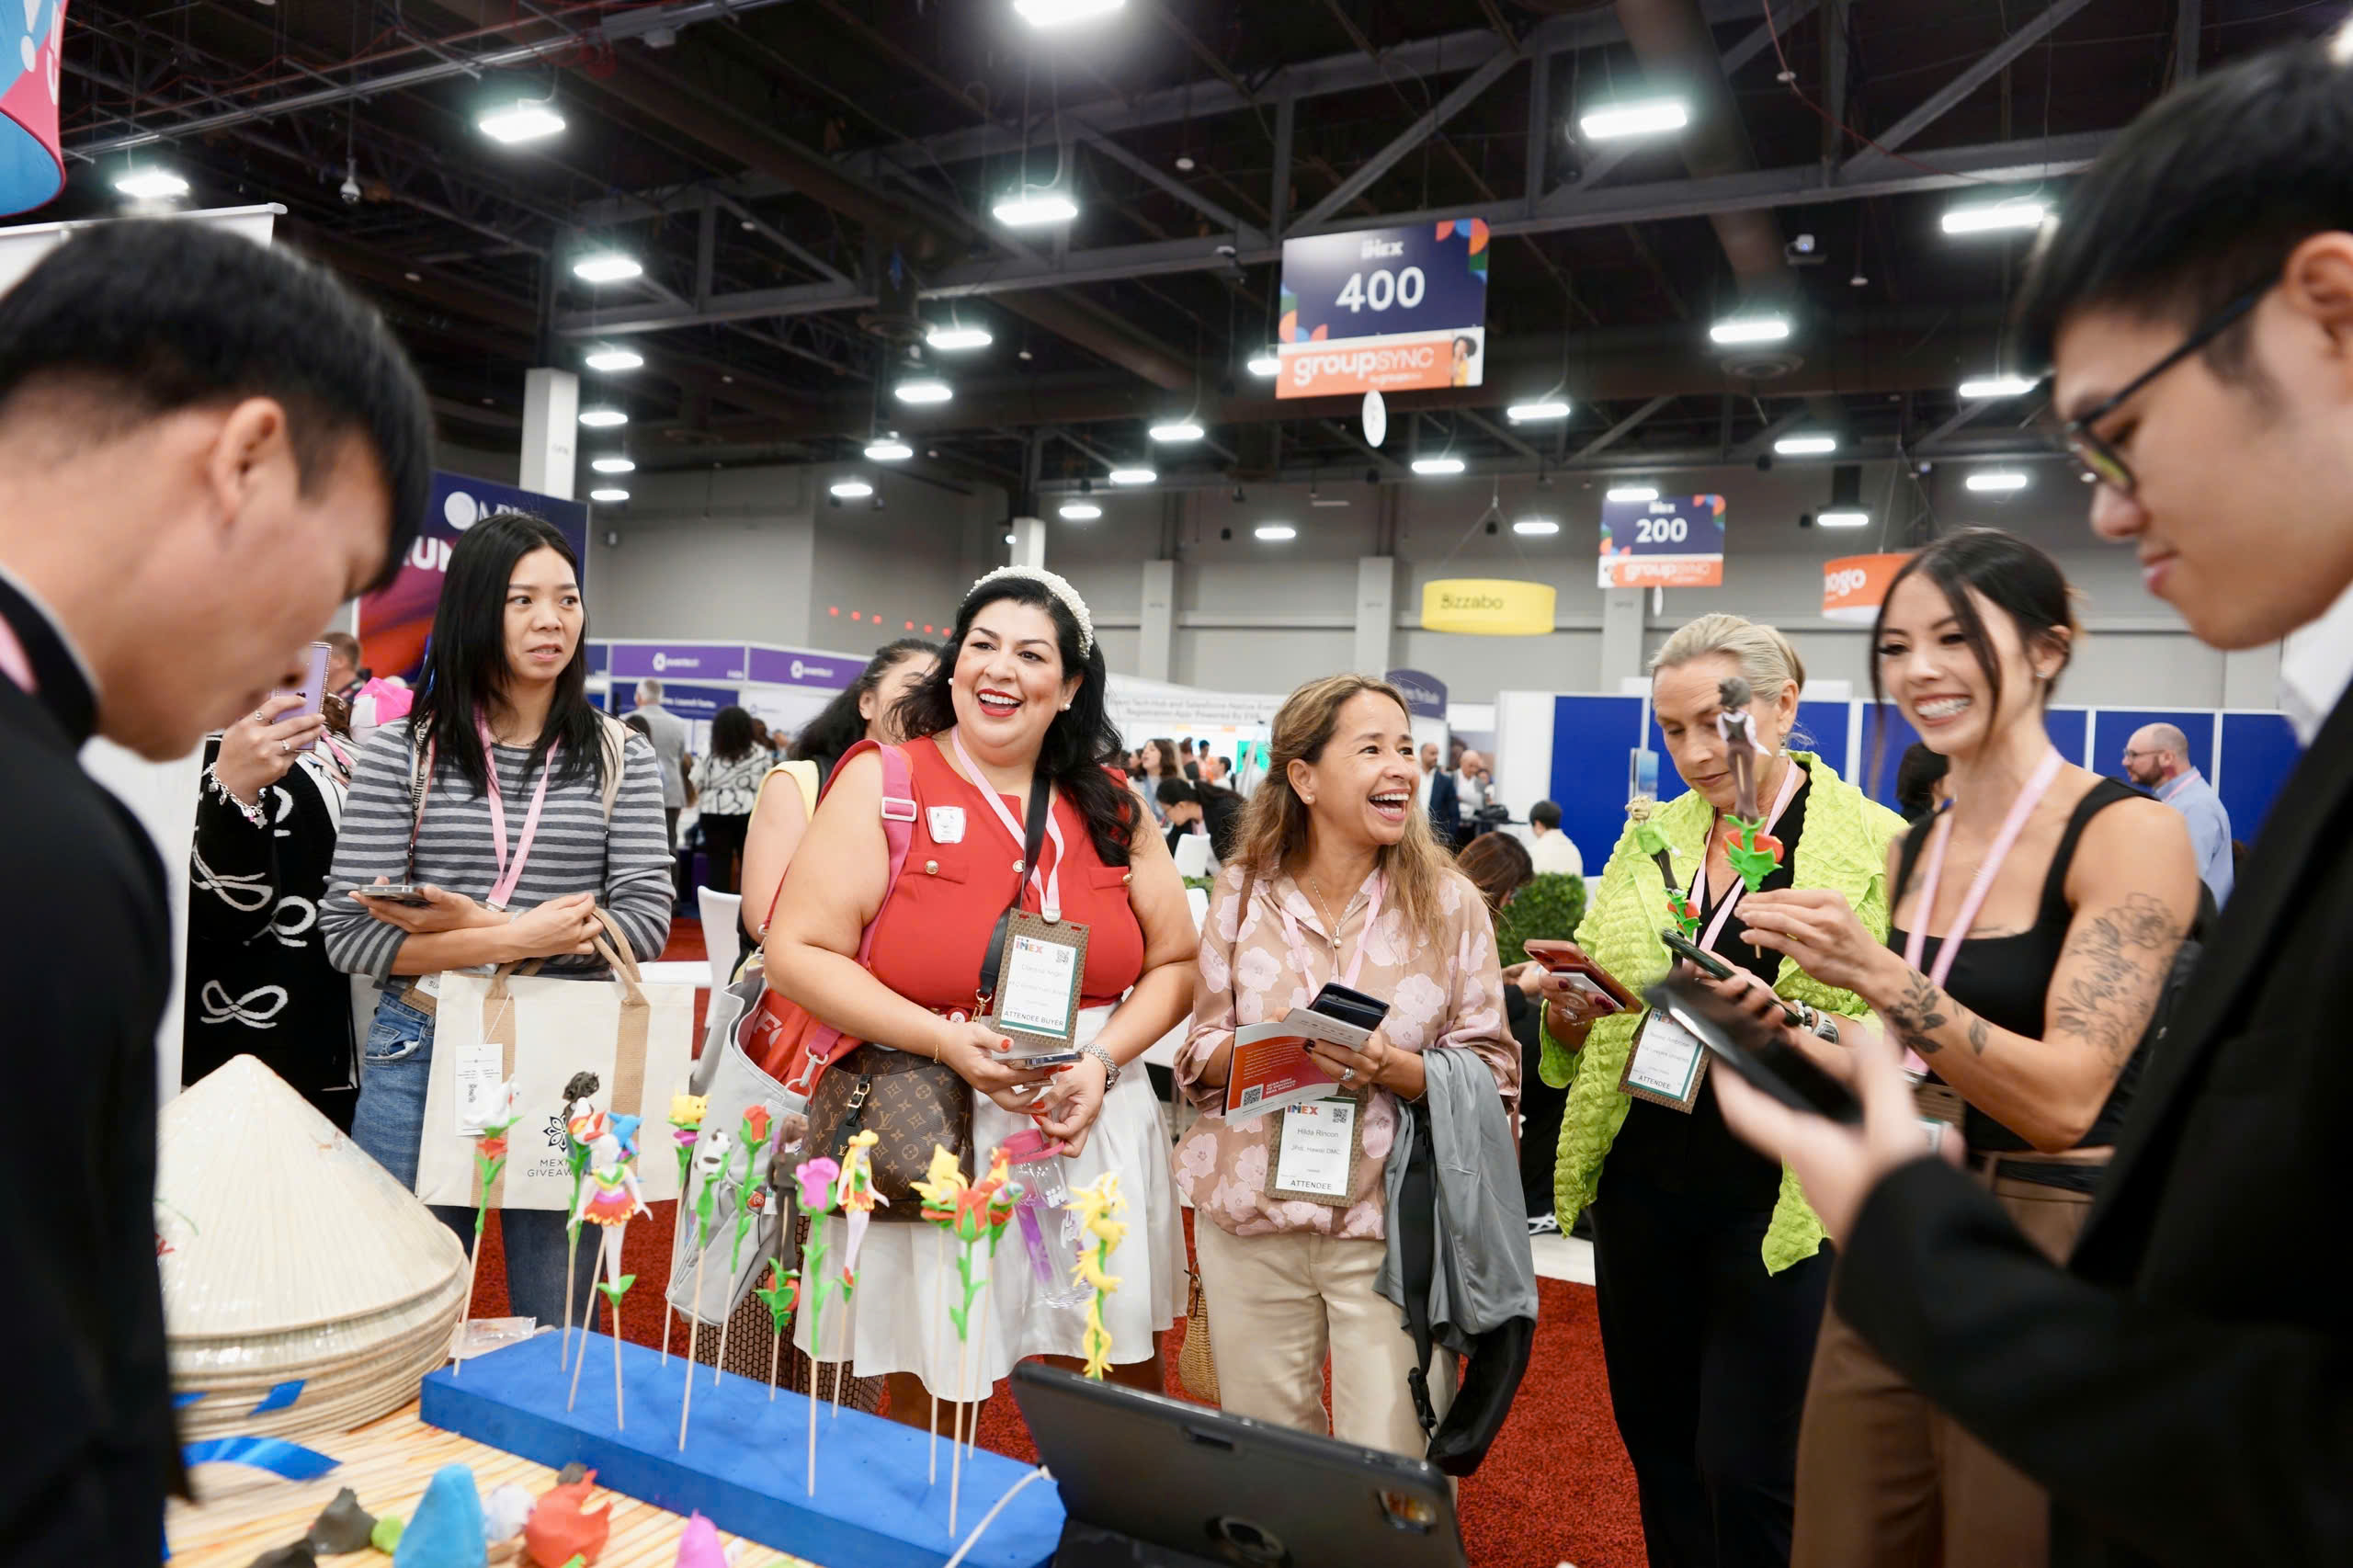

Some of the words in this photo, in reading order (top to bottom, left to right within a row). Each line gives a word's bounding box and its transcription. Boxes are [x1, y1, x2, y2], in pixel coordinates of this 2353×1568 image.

[1336, 267, 1425, 312] 400
[1635, 517, 1688, 543] 200
[1440, 594, 1504, 609] Bizzabo
[1004, 1010, 1040, 1023] ATTENDEE
[1040, 1016, 1063, 1027] BUYER
[1638, 1075, 1671, 1090] ATTENDEE
[1287, 1102, 1318, 1116] IMEX
[1297, 1128, 1314, 1137] Hilda
[1290, 1179, 1332, 1190] ATTENDEE
